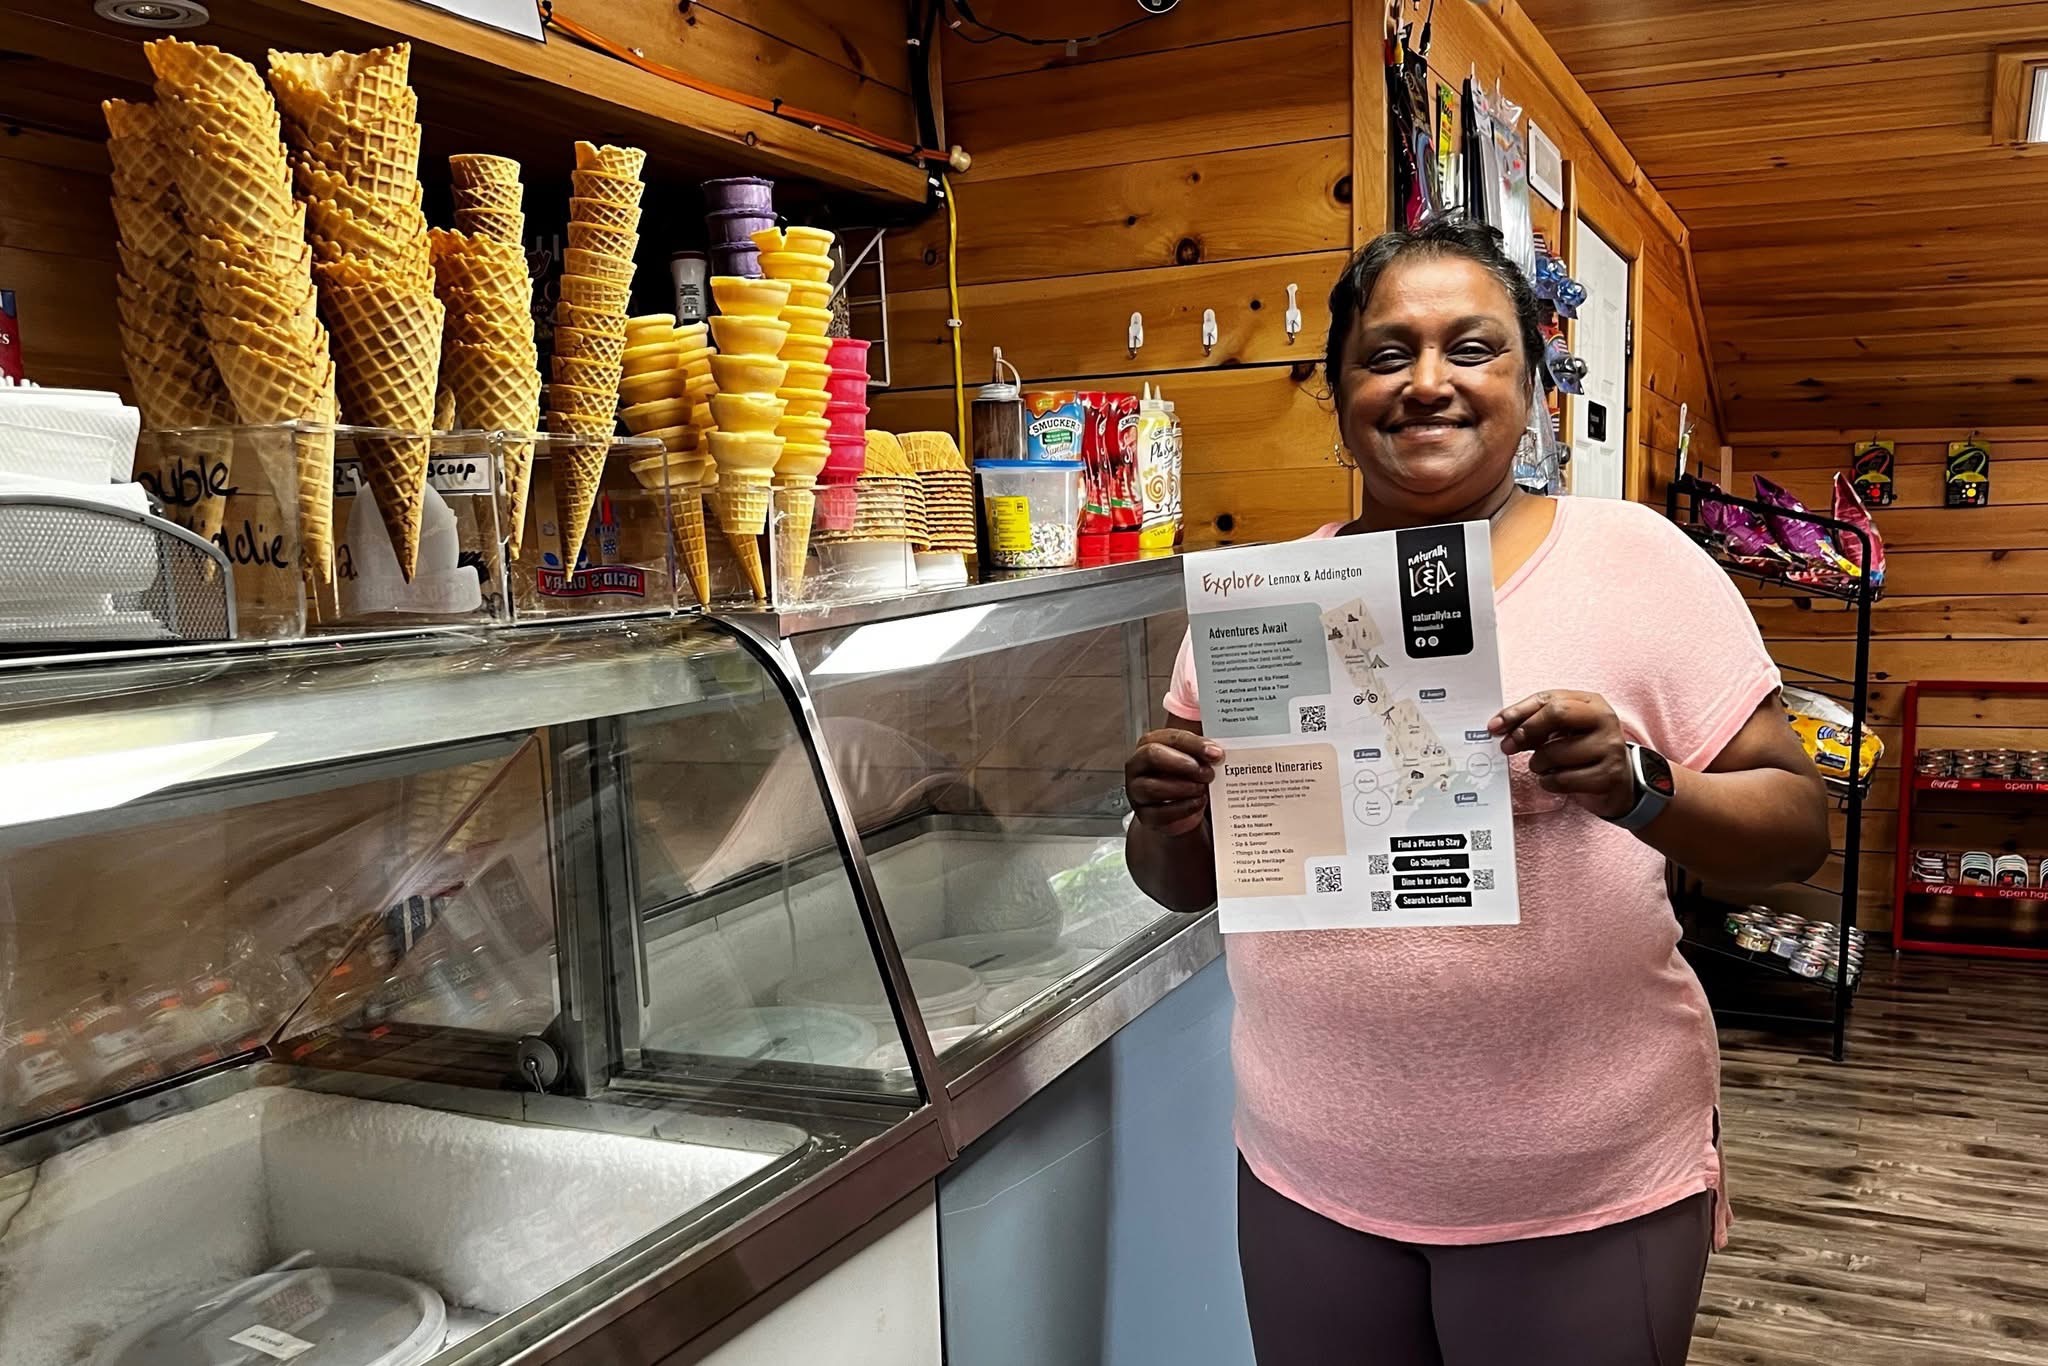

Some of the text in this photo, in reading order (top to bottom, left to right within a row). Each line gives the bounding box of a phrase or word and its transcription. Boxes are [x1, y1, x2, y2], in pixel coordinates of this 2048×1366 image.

[136, 455, 240, 506] ouble
[1408, 545, 1448, 566] naturally
[1203, 567, 1362, 597] Explore Lennox & Addington
[1412, 611, 1462, 622] naturallyla.ca
[1209, 622, 1288, 639] Adventures Await
[1225, 760, 1323, 777] Experience Itineraries
[1398, 840, 1412, 849] Find
[1418, 839, 1436, 847] Place
[1445, 838, 1460, 847] Stay
[1410, 857, 1450, 867] Go Shopping
[1401, 877, 1416, 886] Dine
[1417, 877, 1424, 885] In
[1433, 876, 1449, 885] Take
[1450, 875, 1462, 884] Out
[2000, 889, 2028, 897] open
[1403, 895, 1466, 905] Search Local Events
